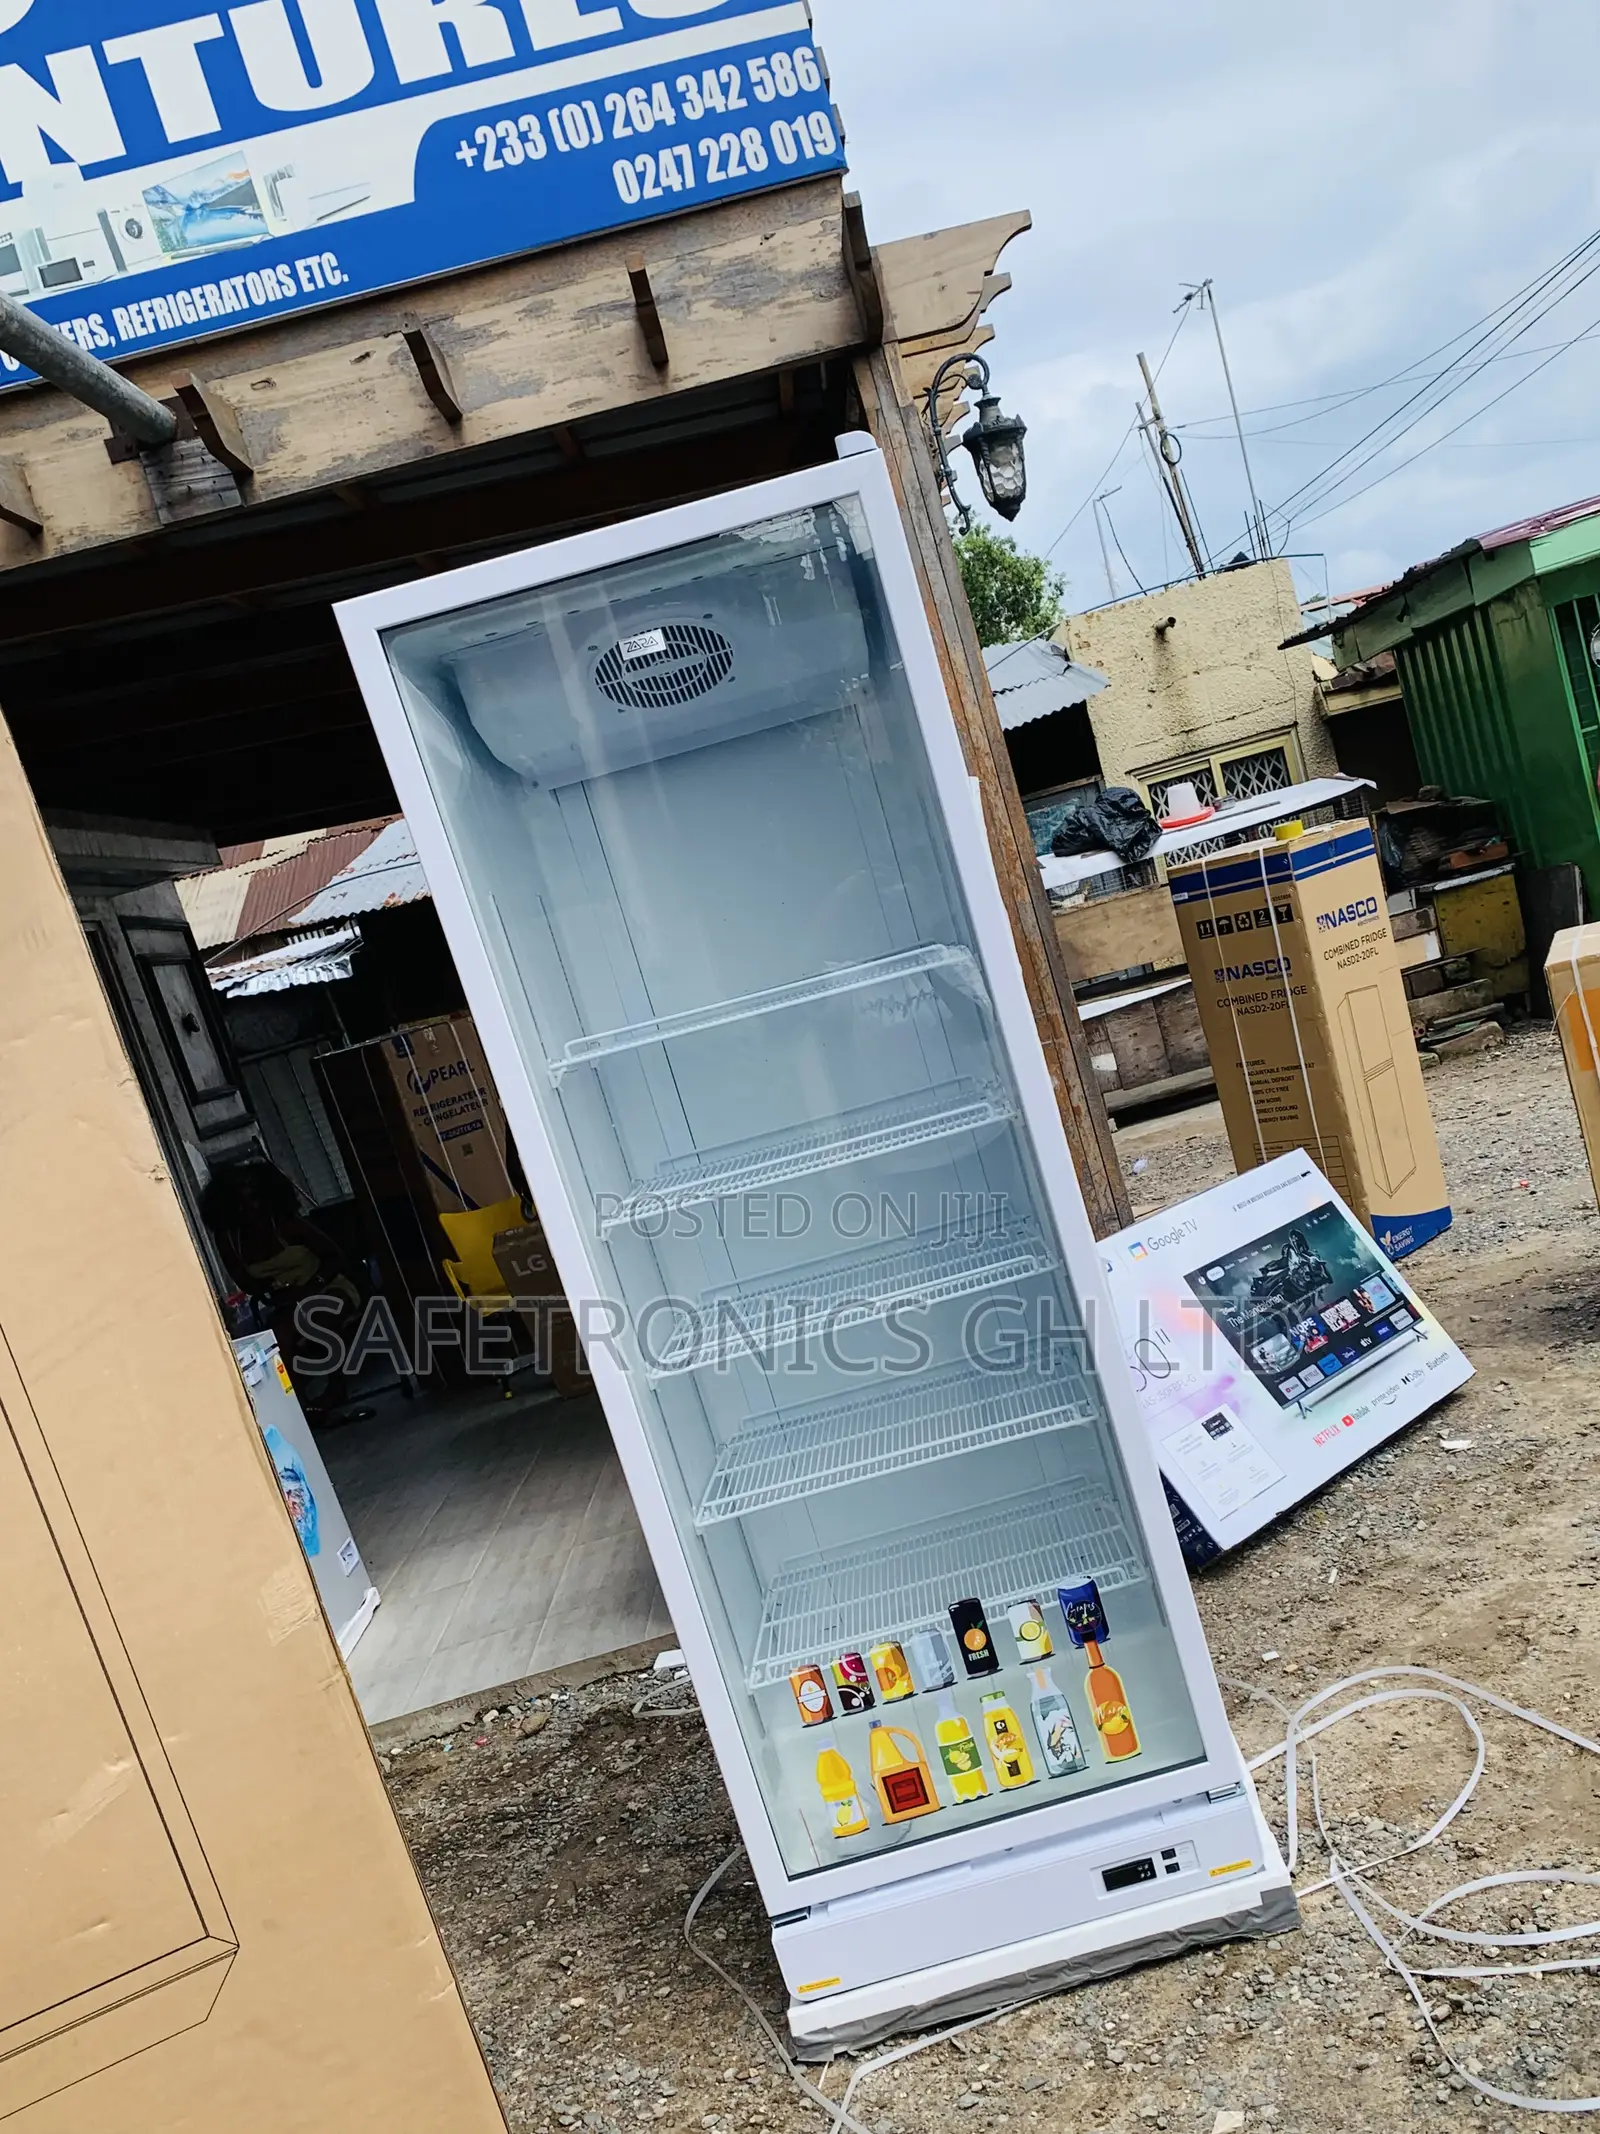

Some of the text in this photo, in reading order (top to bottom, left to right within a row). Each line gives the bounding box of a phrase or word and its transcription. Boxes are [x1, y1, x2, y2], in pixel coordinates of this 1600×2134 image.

[0, 0, 735, 184] NTUR
[455, 46, 821, 172] +233 (0) 264 342 586
[612, 111, 837, 204] 0247 228 019
[111, 263, 298, 342] REFRIGERATORS
[295, 252, 349, 293] ETC.
[1324, 896, 1378, 929] NASCO
[1323, 927, 1387, 961] COMBINED FRIDGE
[1226, 956, 1291, 981] NASCO
[1336, 946, 1379, 970] NASD2-20FL
[1216, 991, 1268, 1008] COMBINED
[429, 1059, 475, 1084] PEARL
[1235, 1059, 1266, 1069] FETURES:
[1147, 1218, 1198, 1251] Google TV
[1391, 1225, 1413, 1244] ENERGY
[1394, 1235, 1415, 1252] SAVING
[511, 1254, 548, 1277] LG
[1227, 1315, 1244, 1328] The
[1289, 1317, 1317, 1338] NOPE
[1312, 1423, 1342, 1447] NETFLIX
[1371, 1393, 1388, 1406] prime
[1386, 1383, 1400, 1396] video
[1407, 1368, 1425, 1381] Dolby
[1425, 1351, 1450, 1371] Bluetooth
[968, 1648, 990, 1662] FRESH
